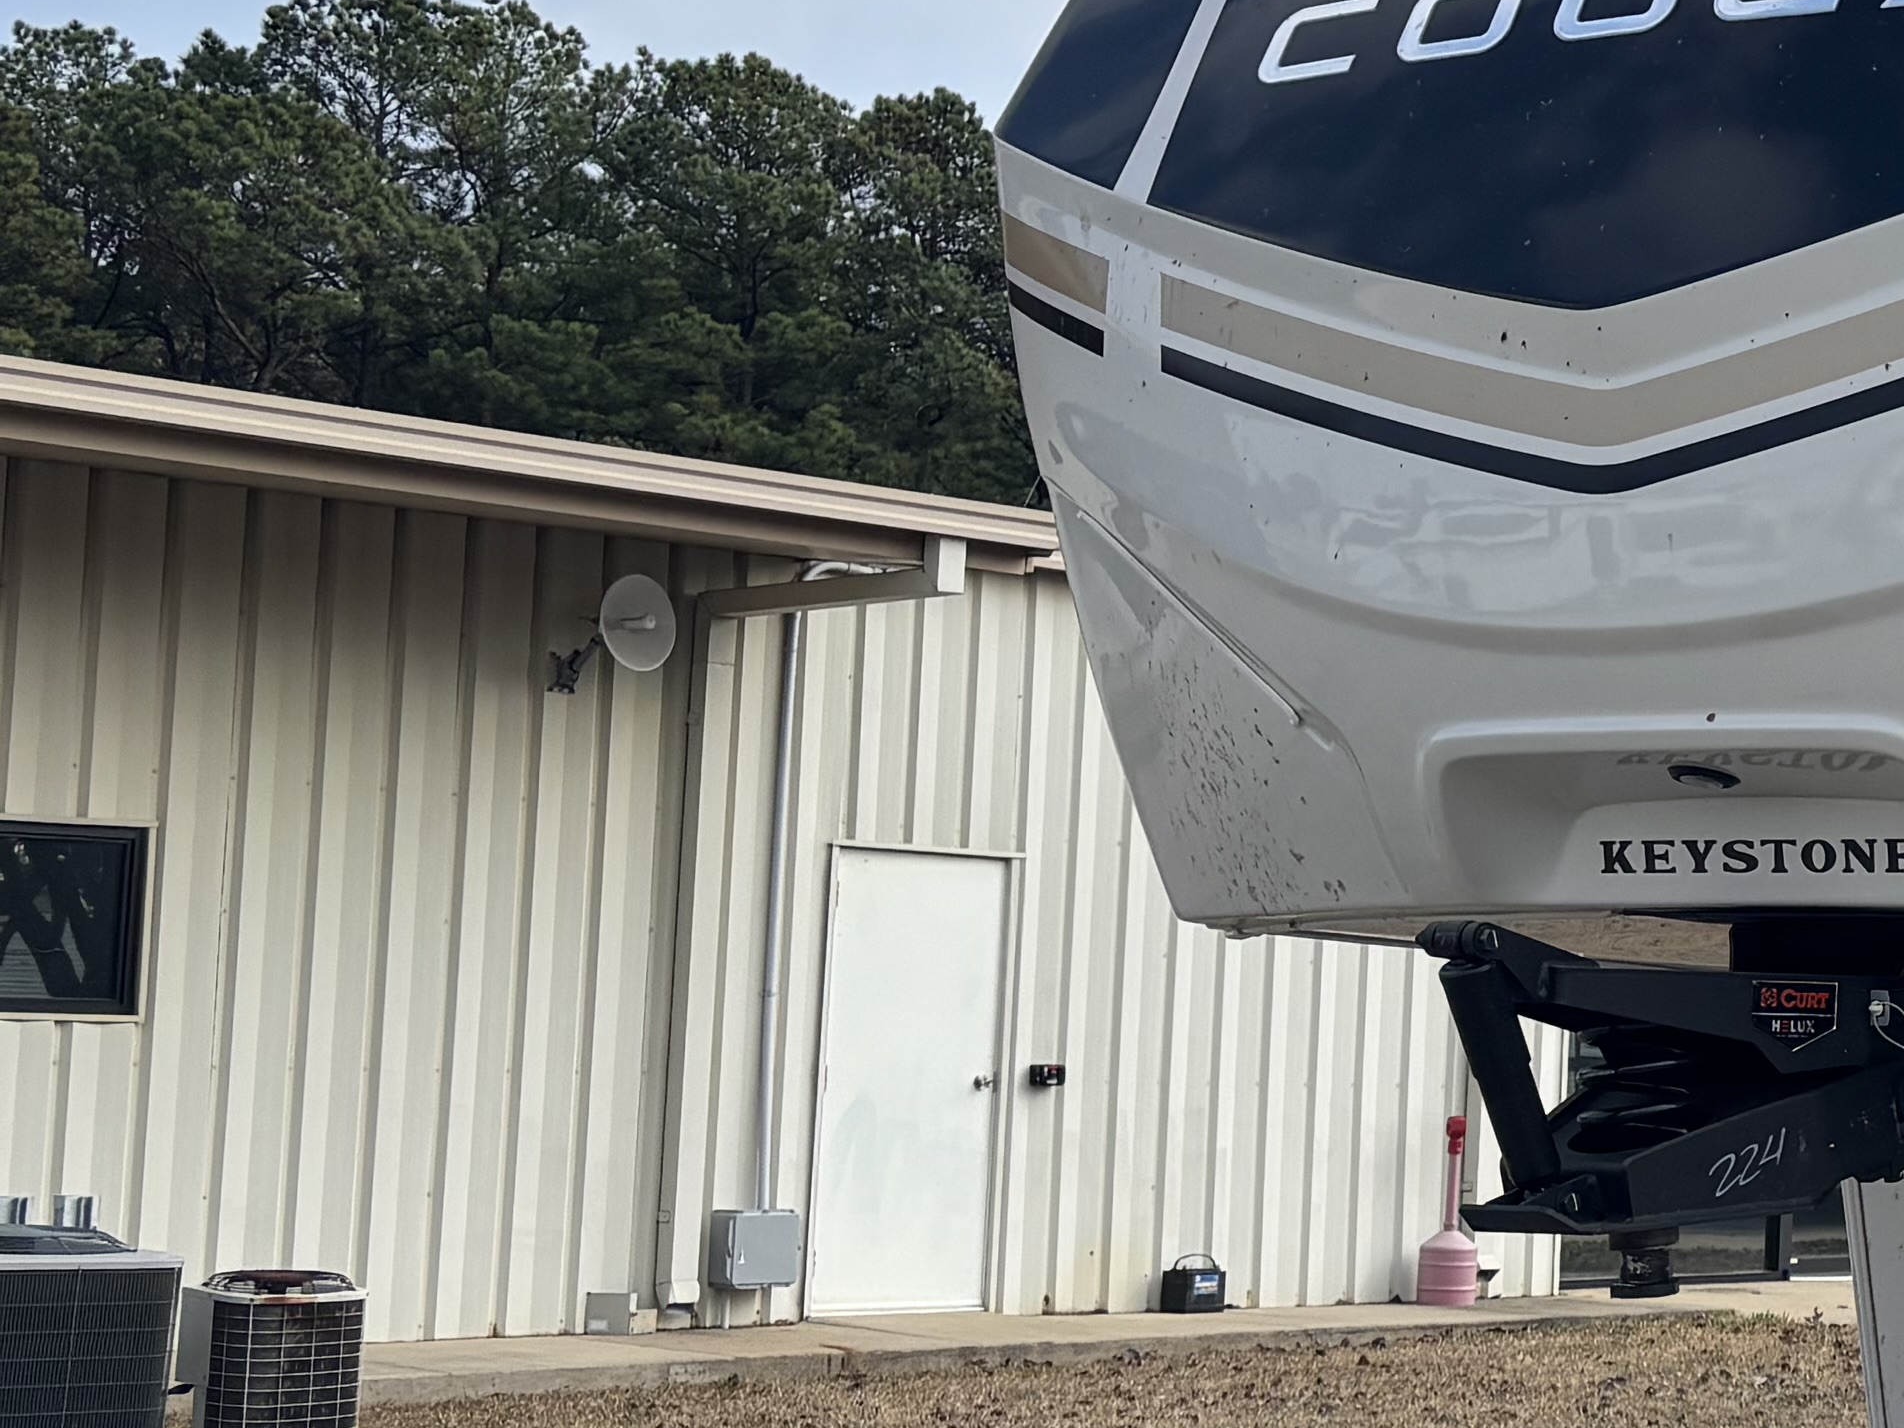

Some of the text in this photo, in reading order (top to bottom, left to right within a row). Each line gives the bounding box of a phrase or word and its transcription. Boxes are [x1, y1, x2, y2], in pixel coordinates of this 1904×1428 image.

[1780, 988, 1830, 1009] CURT
[1771, 1019, 1816, 1033] HELUX
[1708, 1126, 1786, 1197] 224
